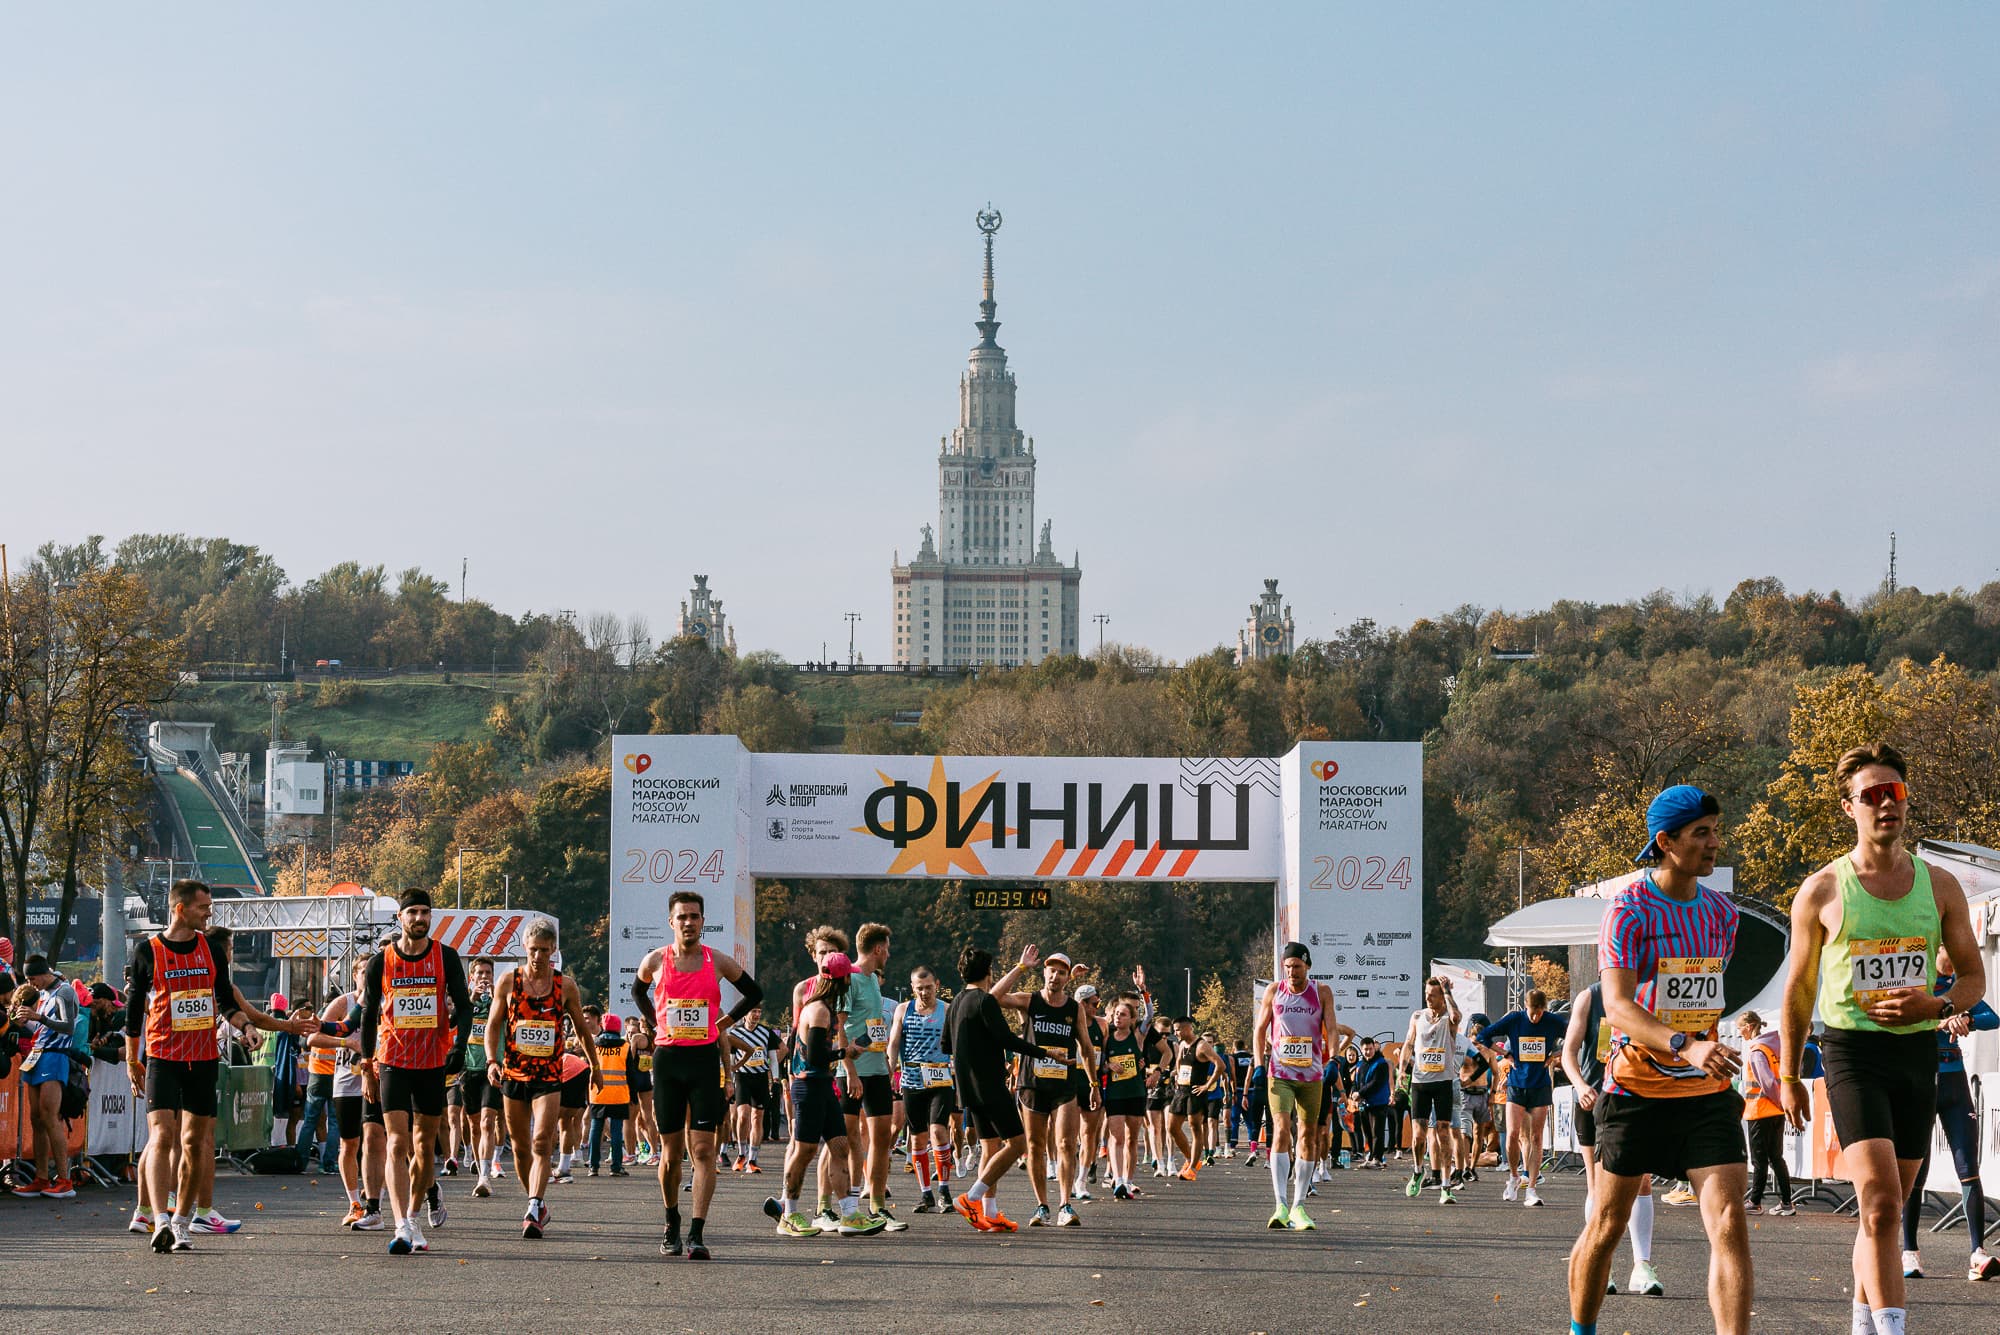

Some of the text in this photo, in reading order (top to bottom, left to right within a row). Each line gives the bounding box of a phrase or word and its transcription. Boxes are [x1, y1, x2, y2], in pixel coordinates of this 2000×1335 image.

[632, 778, 720, 789] МОСКОВСКИЙ
[789, 783, 848, 796] МОСКОВСКИЙ
[1319, 785, 1407, 796] МОСКОВСКИЙ
[632, 790, 696, 801] МАРАФОН
[632, 802, 688, 812] MOSCOW
[789, 796, 817, 807] СПОРТ
[1319, 797, 1383, 807] МАРАФОН
[632, 814, 701, 824] MARATHON
[863, 780, 1250, 851] ФИНИШ
[1319, 809, 1375, 819] MOSCOW
[1319, 820, 1388, 830] MARATHON
[622, 849, 725, 883] 2024
[1310, 855, 1412, 890] 2024
[1855, 954, 1925, 981] 13179
[1667, 977, 1718, 999] 8270
[1877, 979, 1907, 989] ДАНИИЛ
[177, 999, 208, 1013] 6586
[398, 997, 432, 1012] 9304
[1285, 1005, 1317, 1015] insanity
[1678, 1000, 1708, 1009] ГЕОРГИЙ
[676, 1009, 700, 1022] 153
[521, 1028, 550, 1041] 5593
[1034, 1021, 1072, 1037] RUSSIA
[1283, 1044, 1307, 1055] 2021
[1522, 1043, 1542, 1051] 8405
[1422, 1053, 1442, 1062] 9728
[928, 1068, 944, 1078] 706
